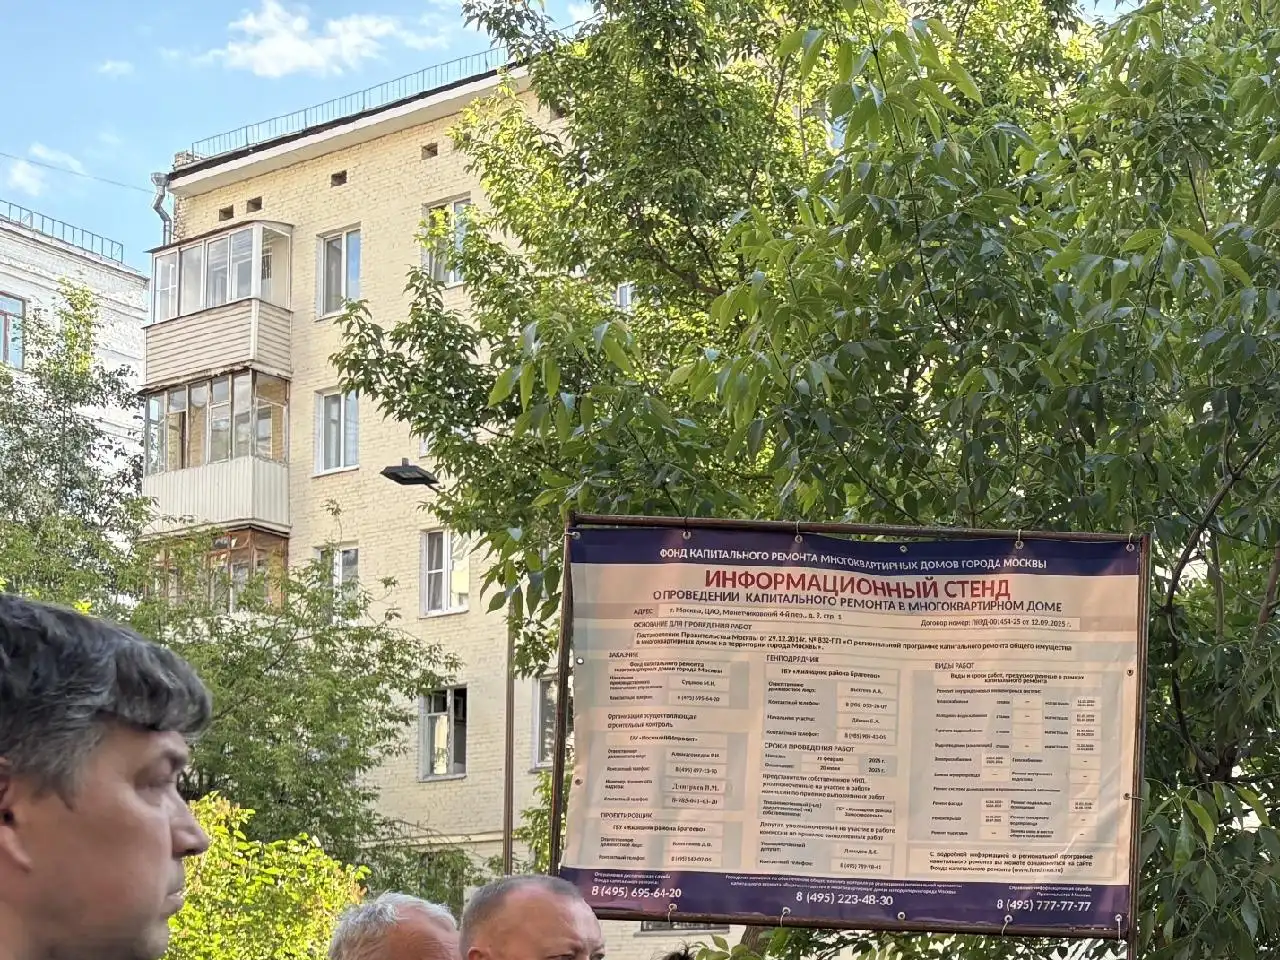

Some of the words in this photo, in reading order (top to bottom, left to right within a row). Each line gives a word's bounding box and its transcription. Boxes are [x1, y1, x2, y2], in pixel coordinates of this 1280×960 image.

[660, 548, 688, 559] ФОНД
[690, 548, 769, 561] КАПИТАЛЬНОГО
[771, 551, 818, 562] РЕМОНТА
[820, 554, 918, 571] МНОГОКВАРТИРНЫХ
[920, 560, 959, 571] ДОМОВ
[961, 560, 1001, 570] ГОРОДА
[1003, 558, 1047, 569] МОСКВЫ
[705, 569, 939, 599] ИНФОРМАЦИОННЫЙ
[944, 579, 1011, 600] СТЕНД
[653, 591, 661, 601] О
[663, 590, 740, 602] ПРОВЕДЕНИИ
[745, 593, 836, 607] КАПИТАЛЬНОГО
[840, 598, 896, 611] РЕМОНТА
[899, 601, 905, 611] В
[908, 601, 1024, 612] МНОГОКВАРТИРНОМ
[1027, 601, 1062, 613] ДОМЕ
[920, 619, 948, 627] Договор
[955, 662, 974, 670] РАБОТ
[591, 885, 599, 896] 8
[600, 885, 629, 898] (495)
[630, 887, 682, 898] 695-64-20
[795, 891, 803, 902] 8
[806, 892, 835, 904] (495)
[837, 893, 894, 906] 223-48-30
[996, 899, 1003, 909] 8
[1006, 900, 1034, 912] (495)
[1036, 901, 1092, 912] 777-77-77
